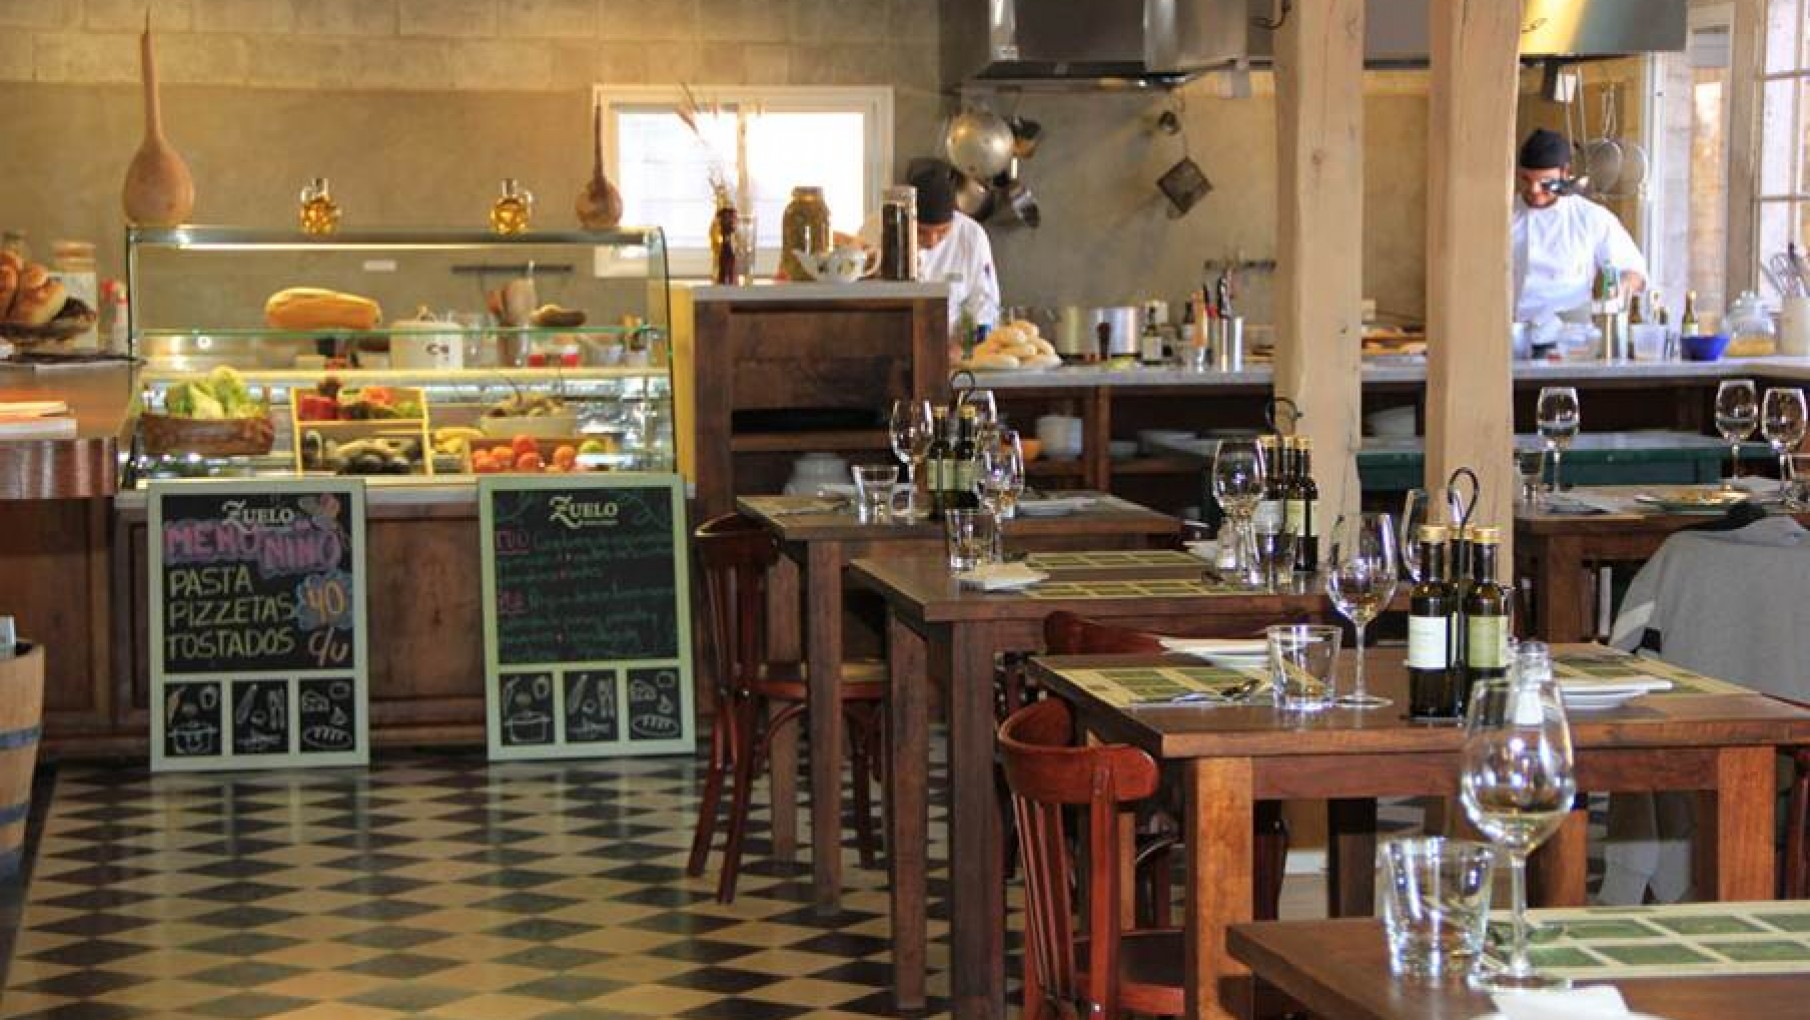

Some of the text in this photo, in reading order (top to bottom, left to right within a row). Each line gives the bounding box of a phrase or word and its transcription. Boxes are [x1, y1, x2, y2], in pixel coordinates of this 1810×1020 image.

[549, 495, 618, 528] ZUELO
[169, 564, 253, 598] PASTA
[169, 592, 295, 627] PIZZETAS
[306, 578, 345, 623] 40
[167, 626, 295, 660] TOSTADOS
